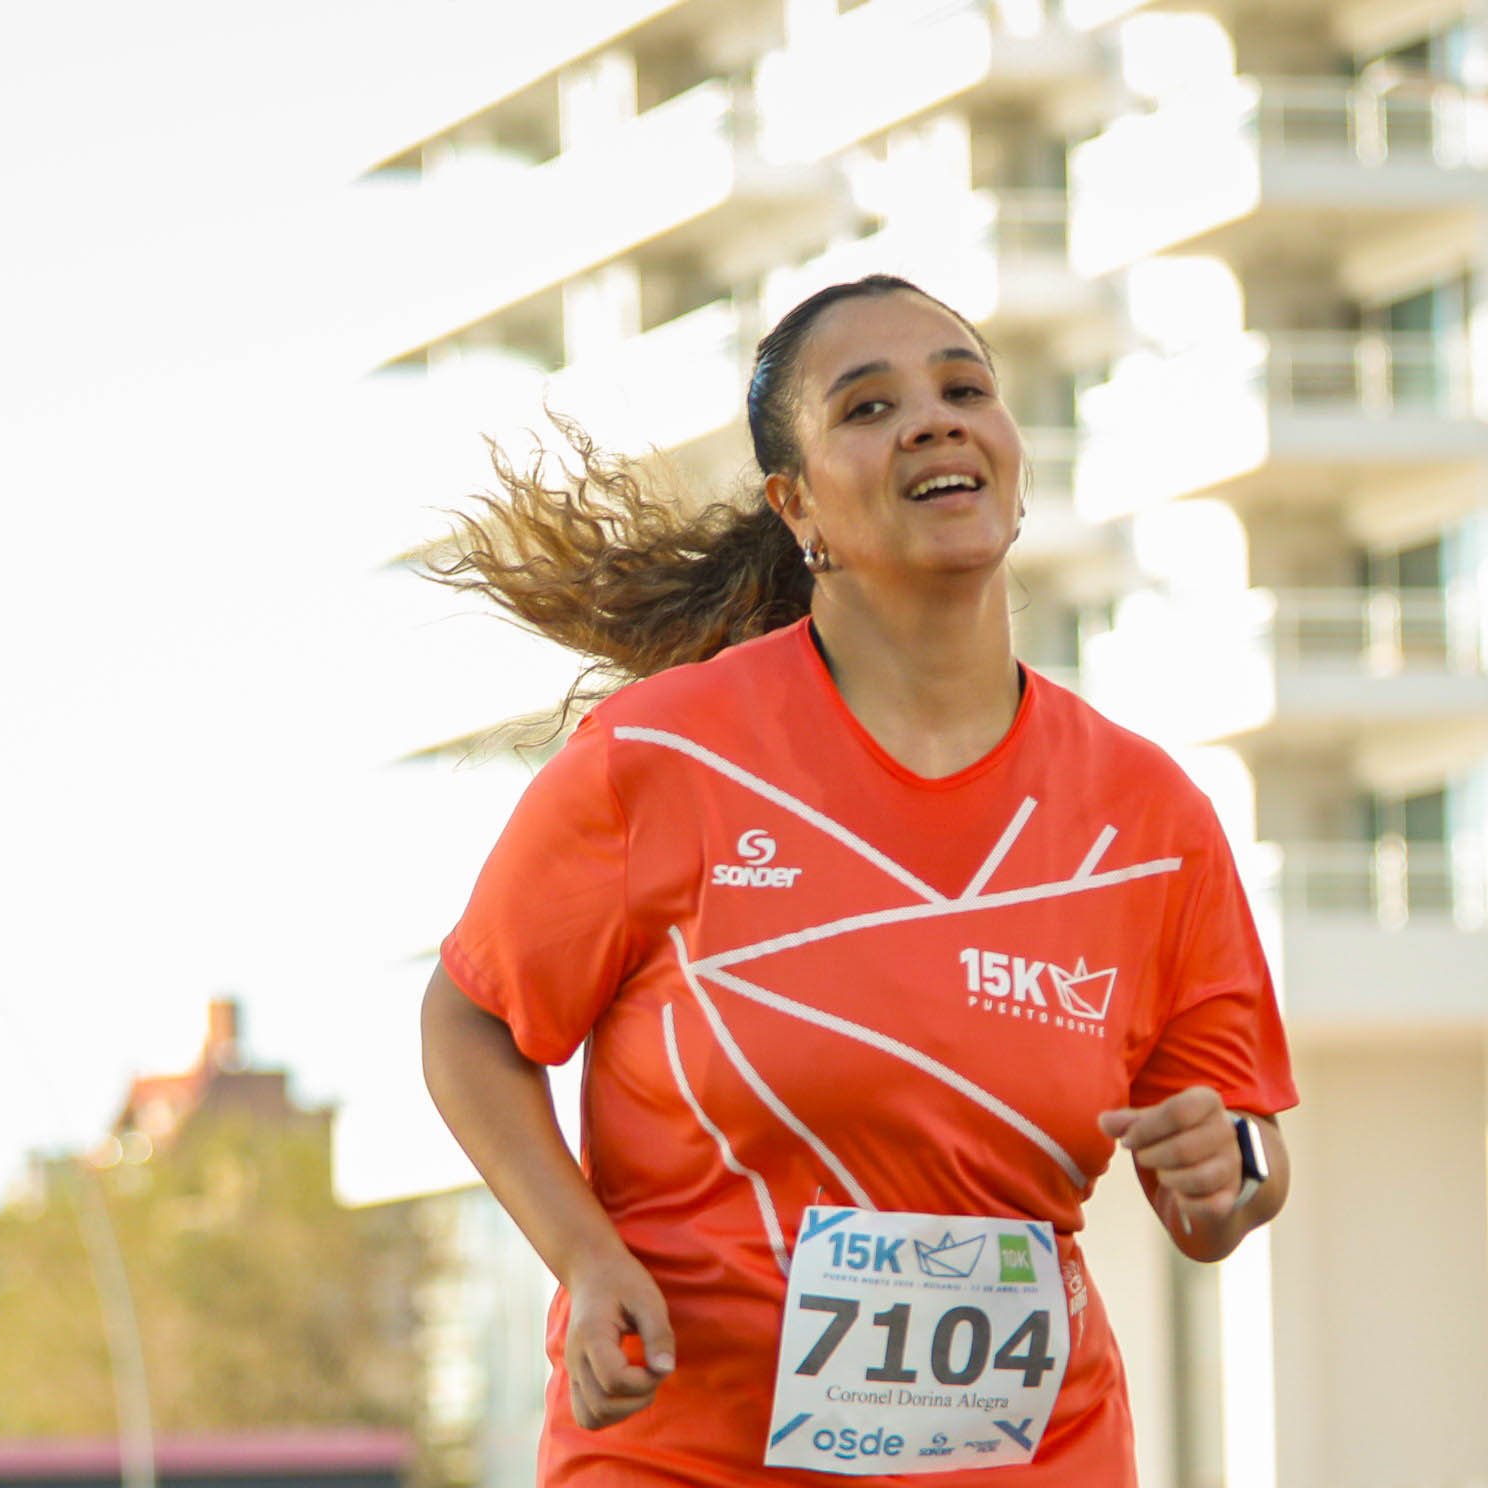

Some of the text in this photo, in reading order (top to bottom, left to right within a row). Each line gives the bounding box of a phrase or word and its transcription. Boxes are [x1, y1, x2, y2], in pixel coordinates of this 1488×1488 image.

[960, 947, 1048, 1007] 15K
[967, 995, 1105, 1038] PUERTO NORTE
[828, 1232, 906, 1273] 15K
[795, 1294, 1055, 1388] 7104
[826, 1385, 1010, 1411] Coronel Dorina Alegra
[813, 1426, 905, 1460] osde
